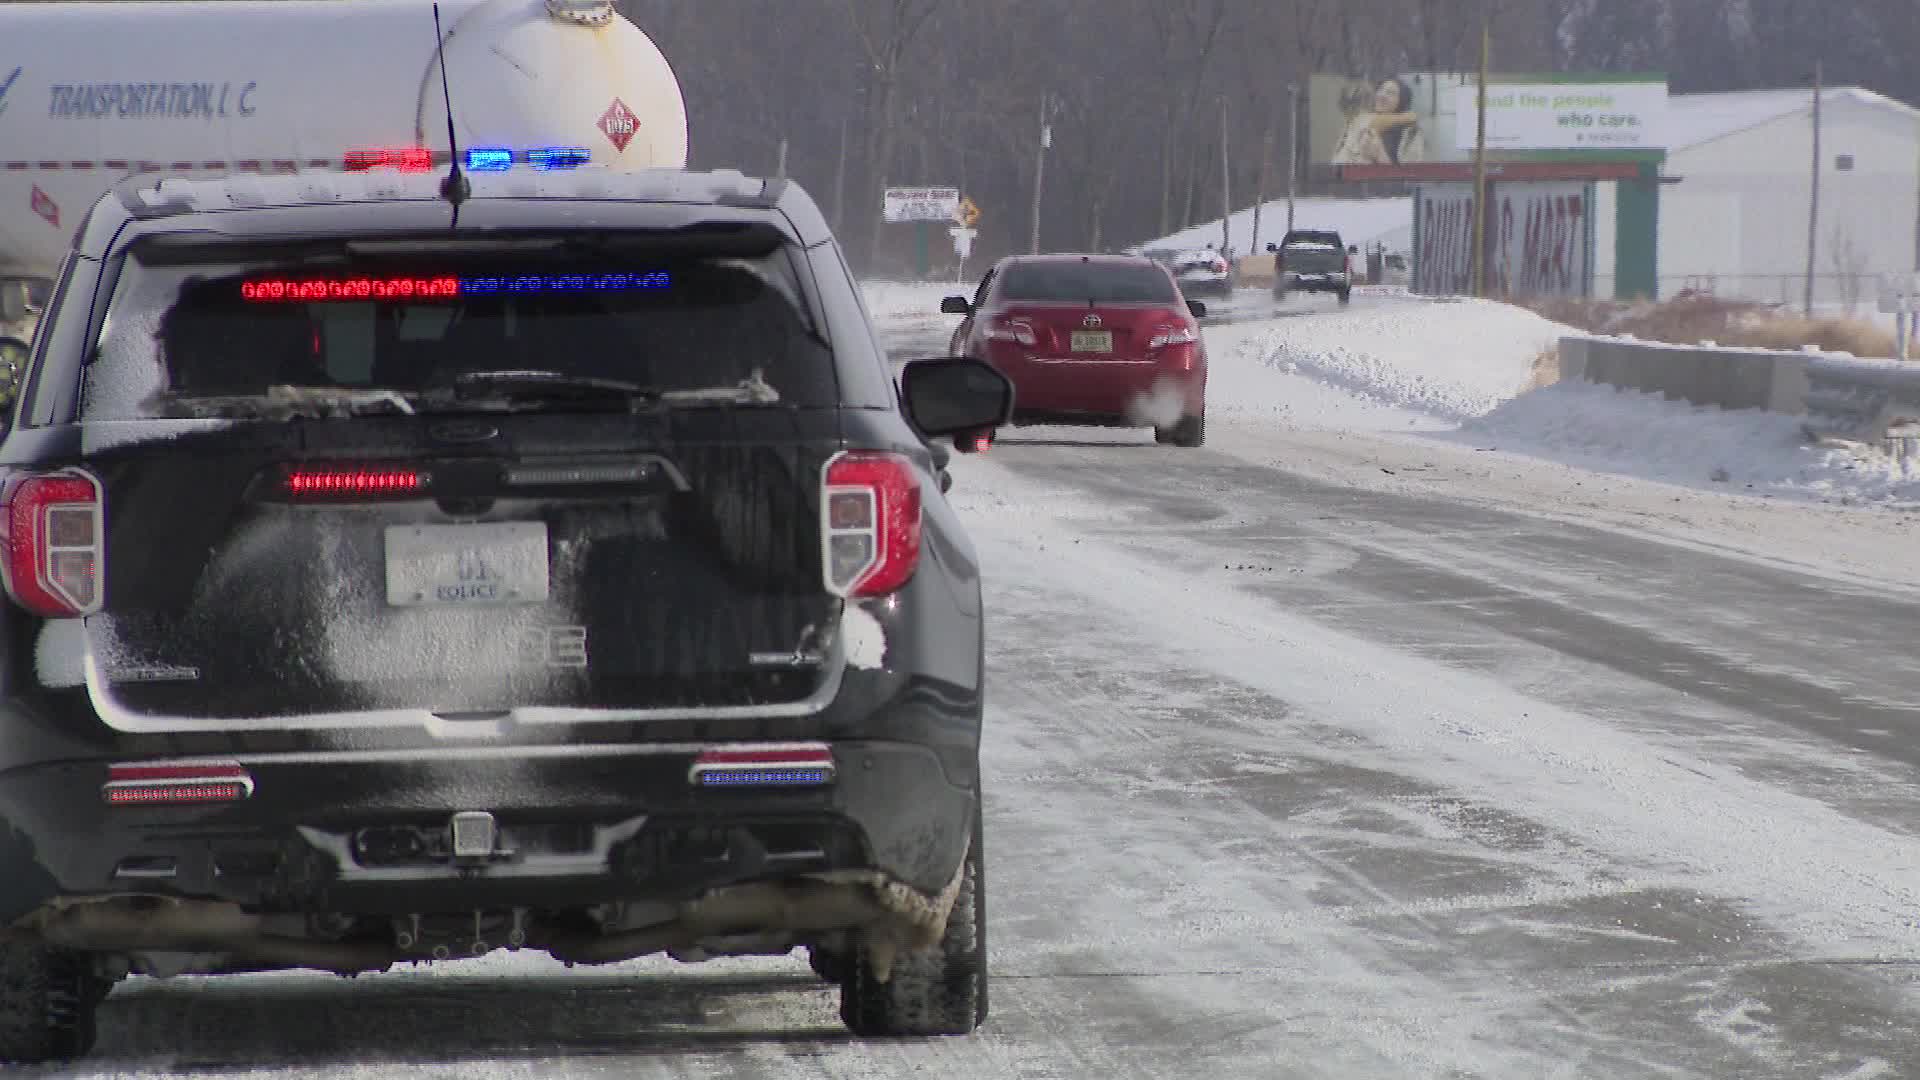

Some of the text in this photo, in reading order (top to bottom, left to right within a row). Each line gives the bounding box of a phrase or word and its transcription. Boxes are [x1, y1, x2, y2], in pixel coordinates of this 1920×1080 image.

[1552, 92, 1617, 110] people
[1557, 112, 1592, 128] who
[1519, 195, 1582, 292] MART
[437, 584, 496, 600] POLICE
